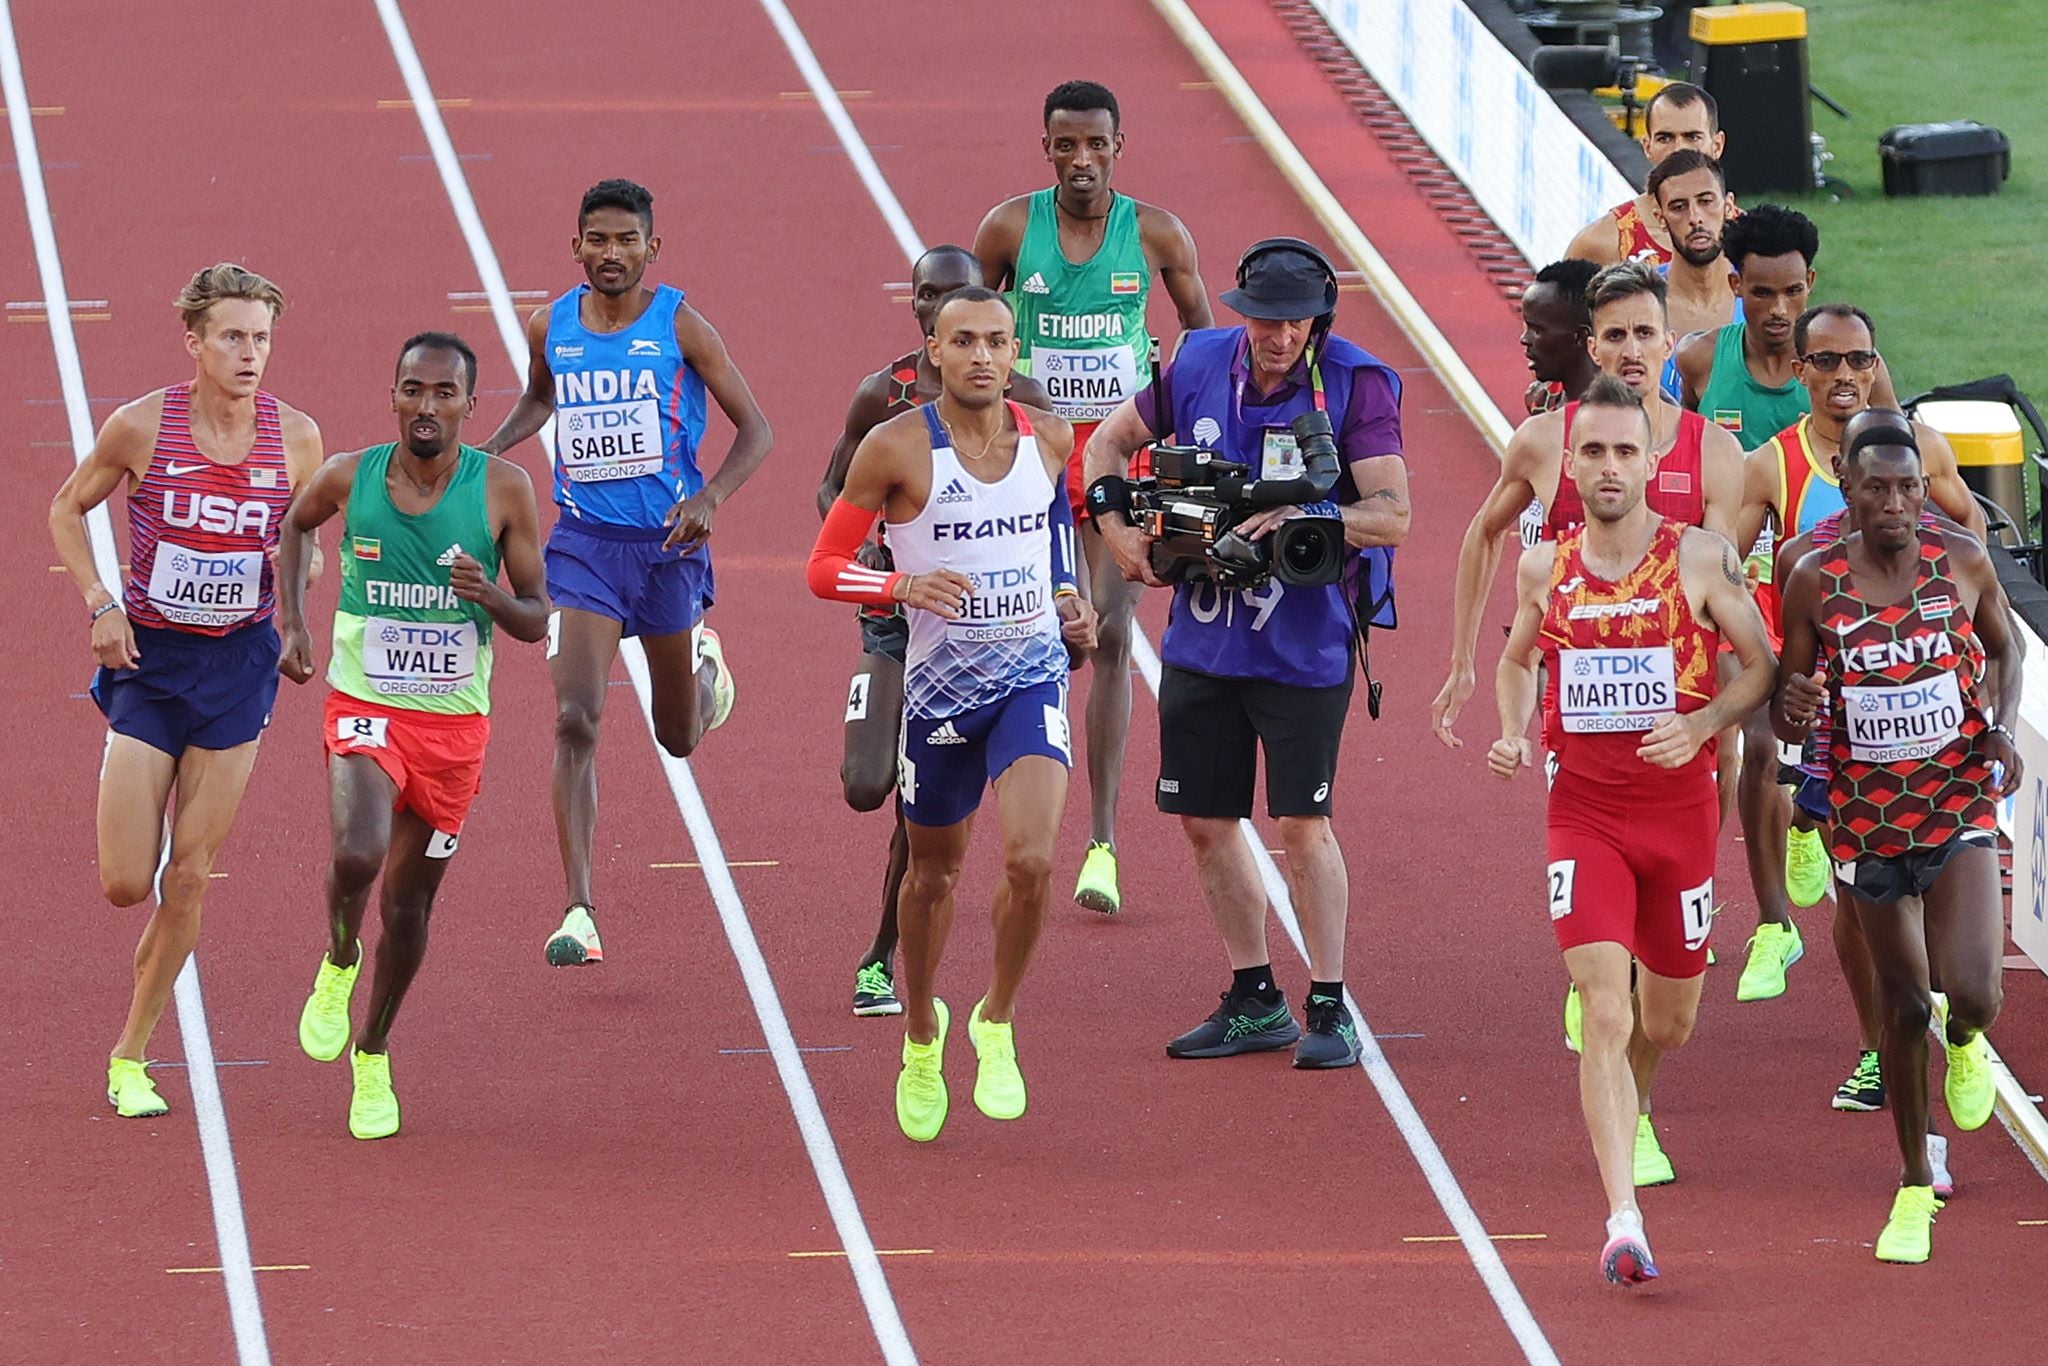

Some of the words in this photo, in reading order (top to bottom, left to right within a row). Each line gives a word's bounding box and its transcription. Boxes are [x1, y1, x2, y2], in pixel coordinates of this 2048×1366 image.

[1038, 313, 1123, 339] ETHIOPIA
[1062, 353, 1120, 372] TDK
[555, 368, 661, 405] INDIA
[1047, 376, 1122, 398] GIRMA
[582, 407, 642, 430] TDK
[571, 432, 645, 460] SABLE
[576, 463, 646, 480] OREGON22
[936, 493, 973, 504] adidas
[163, 490, 271, 538] USA
[190, 557, 247, 577] TDK
[981, 564, 1038, 589] TDK
[166, 578, 243, 604] JAGER
[366, 580, 459, 610] ETHIOPIA
[956, 585, 1043, 619] BELHADJ
[163, 608, 239, 624] OREGON22
[1567, 598, 1662, 620] ESPAÑA
[400, 627, 463, 647] TDK
[386, 649, 457, 674] WALE
[1840, 630, 1954, 673] KENYA
[1590, 655, 1656, 675] TDK
[379, 681, 457, 695] OREGON22
[849, 683, 862, 711] 4
[1567, 681, 1668, 708] MARTOS
[1878, 684, 1943, 711] TDK
[353, 717, 374, 736] 8
[1577, 715, 1656, 730] OREGON22
[1854, 705, 1957, 742] KIPRUTO
[926, 736, 968, 745] adidas
